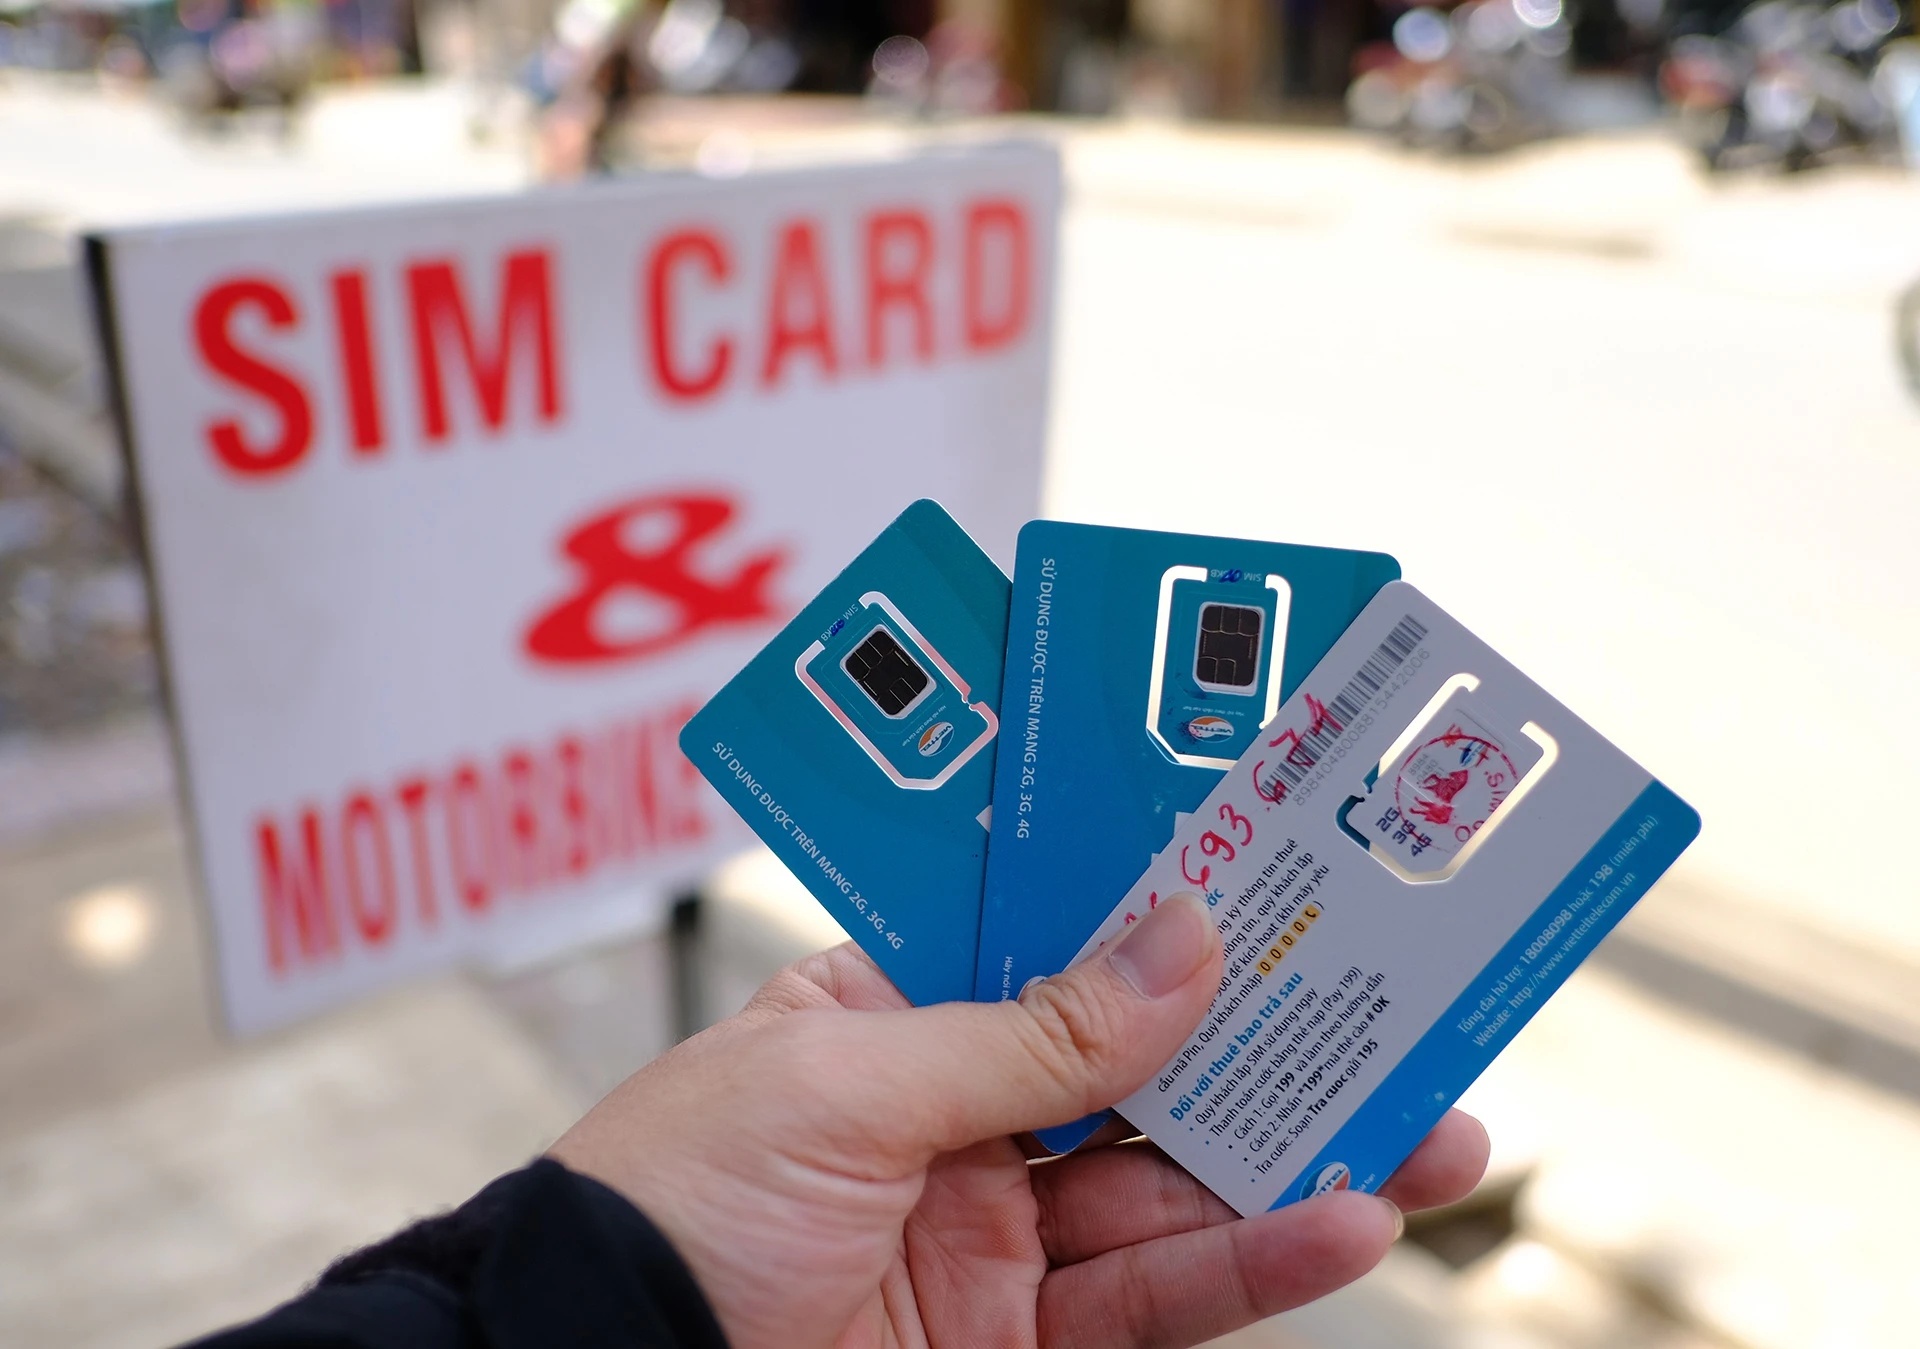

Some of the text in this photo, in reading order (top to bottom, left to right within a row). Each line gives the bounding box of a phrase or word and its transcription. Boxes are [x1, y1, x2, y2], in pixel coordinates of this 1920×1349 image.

[191, 194, 1034, 478] SIM CARD
[520, 488, 793, 670] &
[842, 603, 858, 619] SIM
[1243, 572, 1261, 581] SIM
[920, 722, 951, 754] VIETTEL
[1016, 557, 1057, 838] SỬ DỤNG ĐƯỢC TRÊN MẠNG 2G, 3G, 4G
[712, 742, 903, 949] SỬ DỤNG ĐƯỢC TRÊN MẠNG 2G, 3G, 4G
[1225, 904, 1241, 919] ký
[1237, 877, 1267, 906] thông
[1262, 863, 1278, 877] tin
[1274, 838, 1297, 862] thuê
[1375, 806, 1401, 832] 2G
[1392, 819, 1416, 844] 3G
[1411, 832, 1432, 856] 4G
[1229, 961, 1243, 978] để
[1237, 945, 1260, 965] kích
[1254, 923, 1279, 946] hoạt
[1274, 902, 1295, 924] (khi
[1292, 882, 1313, 905] máy
[1310, 864, 1329, 886] yêu
[1241, 918, 1260, 932] tin,
[1257, 895, 1275, 916] quý
[1269, 868, 1299, 897] khách
[1294, 852, 1313, 869] lắp
[1456, 1009, 1485, 1033] Tổng
[1479, 994, 1496, 1011] đài
[1519, 908, 1572, 964] 18008098
[1588, 864, 1613, 886] 198
[1169, 1094, 1195, 1121] Đối
[1190, 1073, 1213, 1097] với
[1208, 1042, 1240, 1076] thuê
[1233, 1019, 1262, 1046] bao
[1258, 995, 1282, 1019] trả
[1278, 972, 1303, 998] sau
[1171, 1057, 1188, 1076] mã
[1182, 1044, 1204, 1061] Pin,
[1198, 1021, 1219, 1042] Quý
[1212, 996, 1242, 1025] khách
[1238, 973, 1262, 998] nhập
[1194, 987, 1317, 1124] Quý khách lắp SIM sử dụng ngay
[1208, 966, 1362, 1136] Thanh toán cước bằng thẻ nạp (Pay 199)
[1233, 972, 1384, 1139] Cách 1: Gọi 199 và làm theo hướng dẫn
[1249, 1130, 1272, 1151] Cách
[1267, 1120, 1281, 1131] 2:
[1275, 1096, 1302, 1122] Nhấn
[1336, 1035, 1354, 1054] thẻ
[1351, 1020, 1368, 1038] cào
[1371, 995, 1389, 1013] OK
[1472, 1006, 1513, 1046] Website:
[1254, 1038, 1377, 1174] Tra cước: Soạn Tra cuoc gửi 195
